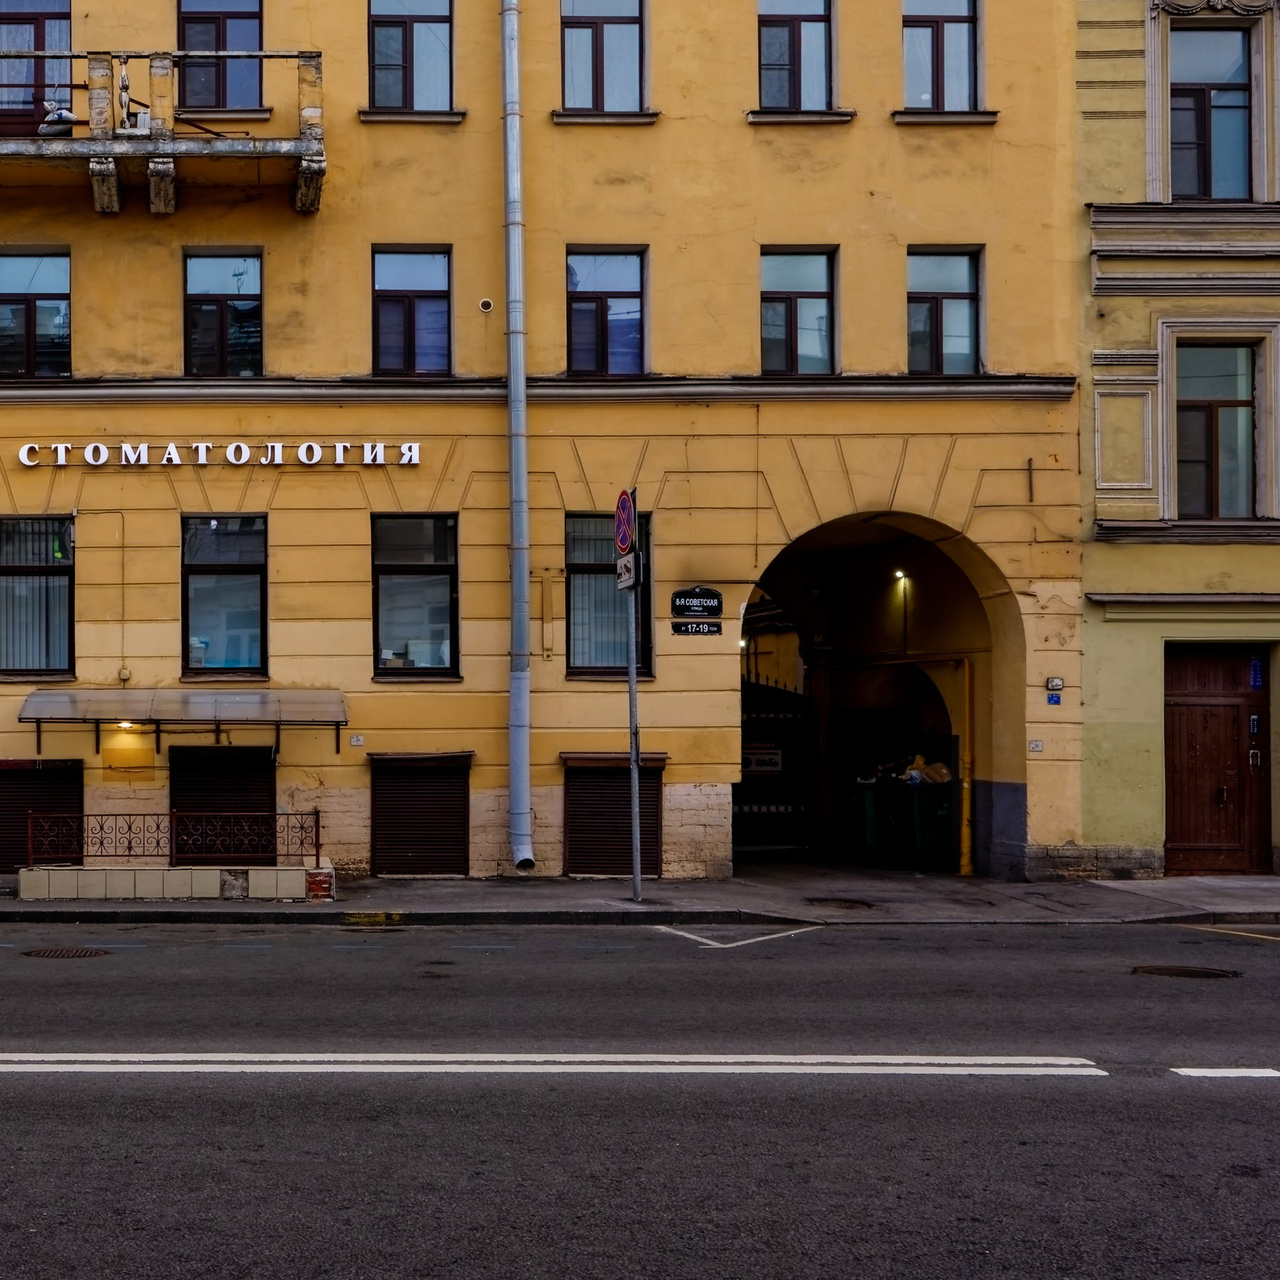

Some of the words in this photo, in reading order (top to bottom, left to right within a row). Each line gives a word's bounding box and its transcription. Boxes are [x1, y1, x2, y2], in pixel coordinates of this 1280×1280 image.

[18, 442, 421, 466] СТОМАТОЛОГИЯ
[676, 598, 685, 606] 8-Я
[685, 598, 718, 606] СОВЕТСКАЯ
[687, 623, 709, 633] 17-19
